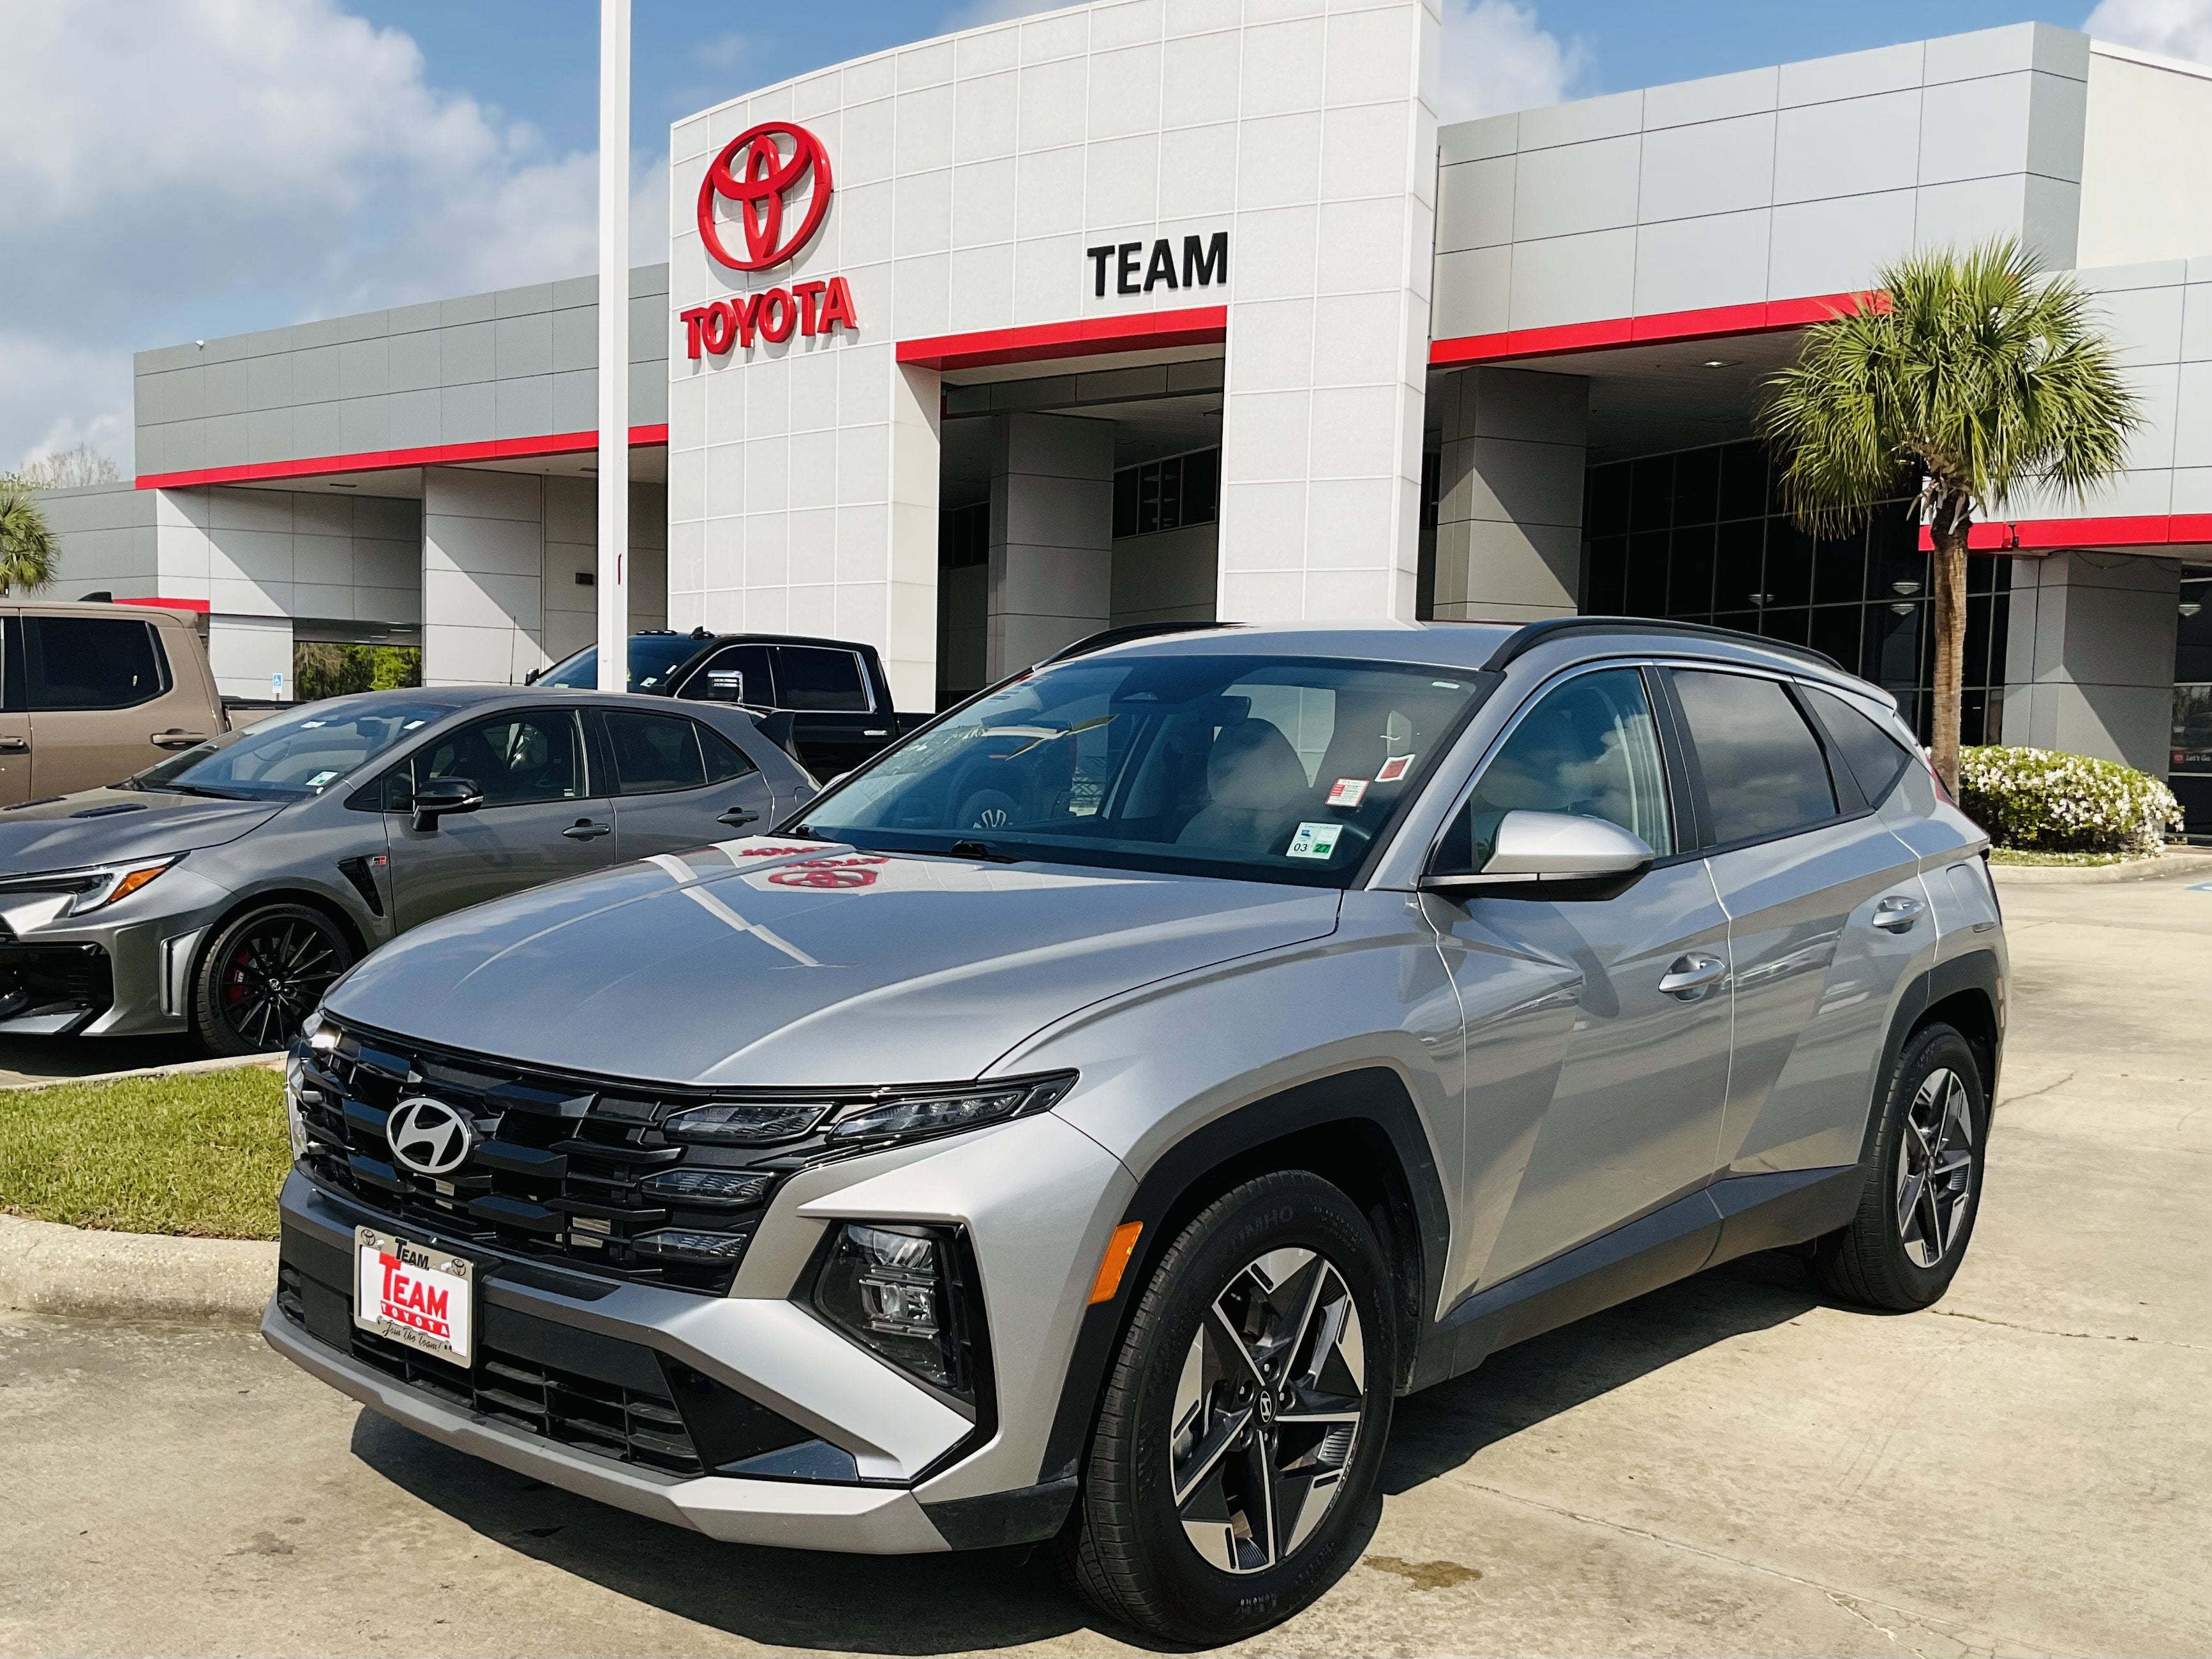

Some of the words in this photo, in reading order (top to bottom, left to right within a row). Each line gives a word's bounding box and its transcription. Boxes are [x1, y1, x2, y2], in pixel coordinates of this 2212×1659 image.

[1087, 231, 1228, 297] TEAM
[680, 276, 858, 359] TOYOTA
[1294, 843, 1308, 852] 03
[1315, 844, 1331, 853] 27
[379, 1252, 448, 1319] TEAM
[381, 1303, 448, 1335] TOYOTA
